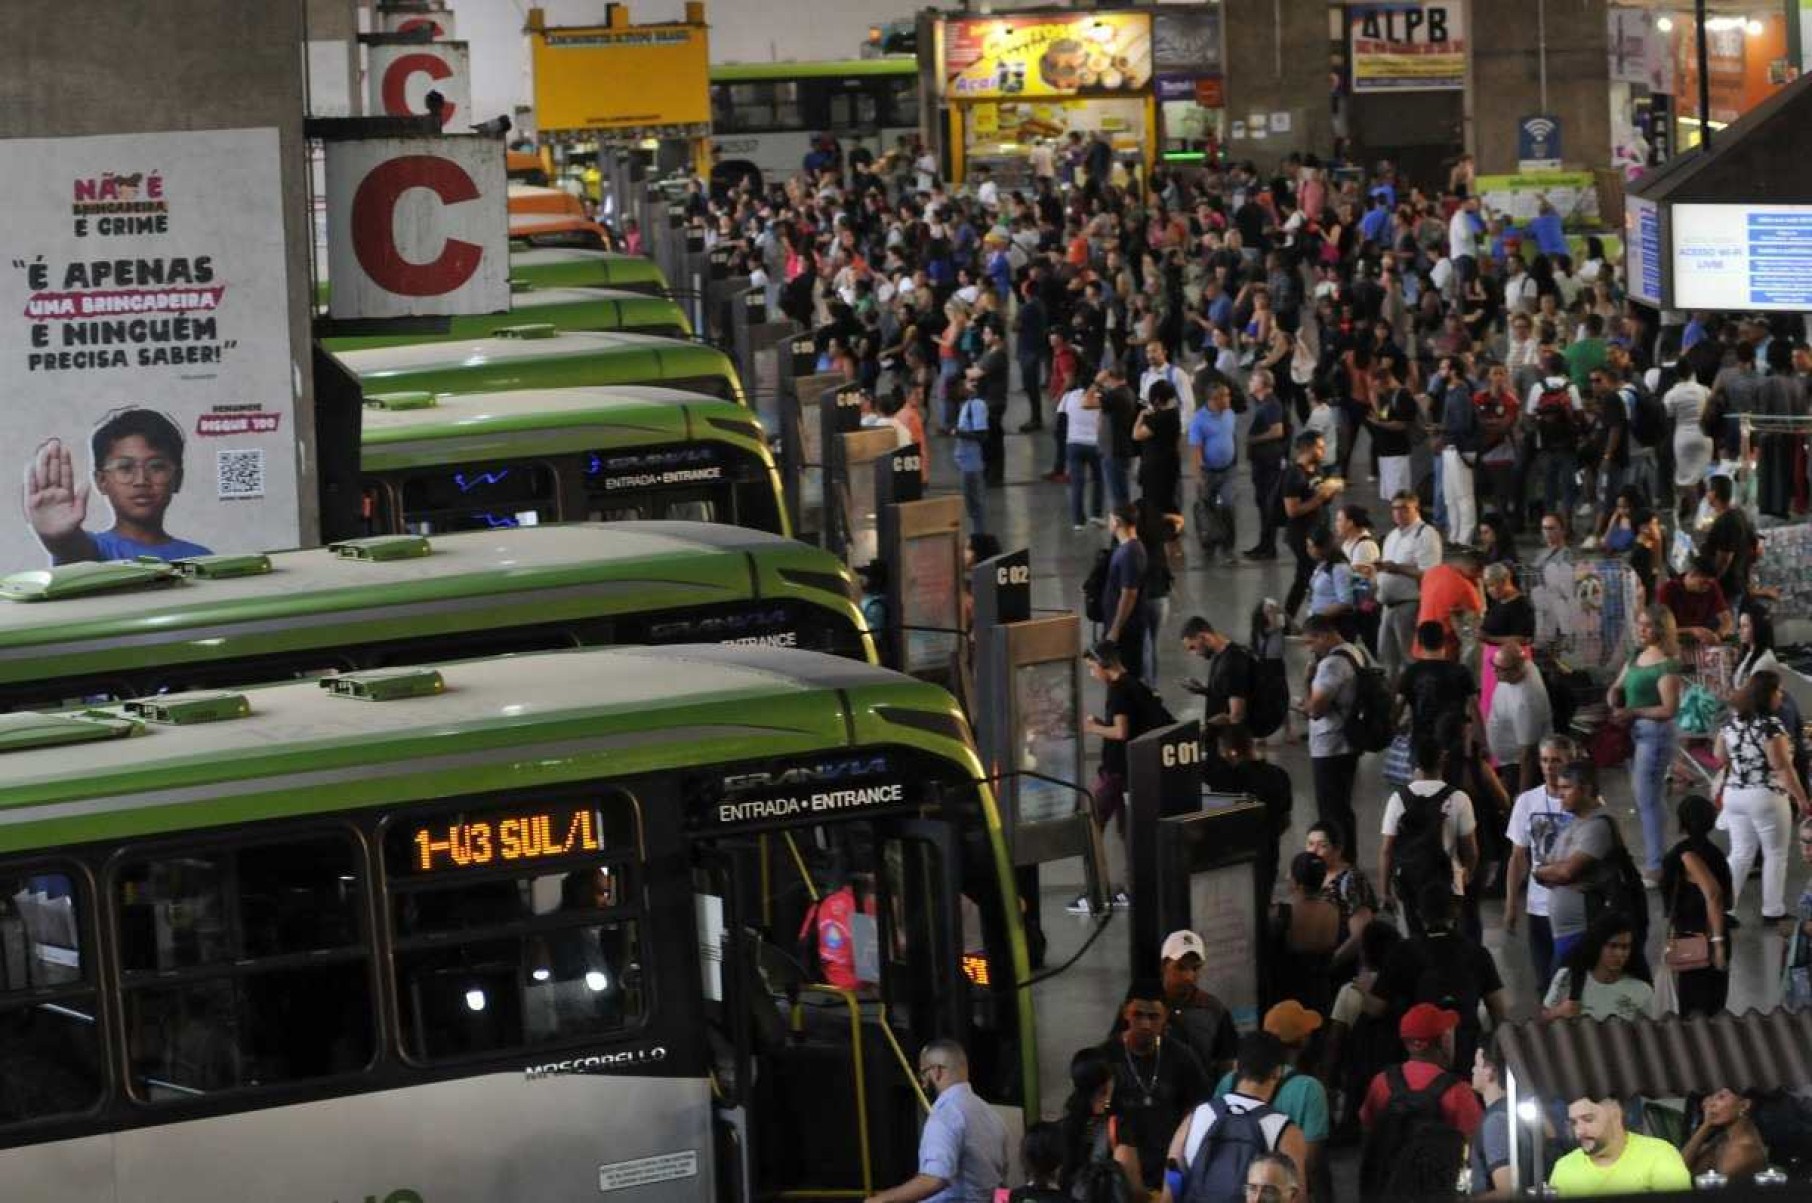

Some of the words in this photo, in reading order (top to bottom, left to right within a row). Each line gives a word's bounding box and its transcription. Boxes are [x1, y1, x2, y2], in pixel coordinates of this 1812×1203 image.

[1361, 8, 1448, 43] ALPB
[382, 53, 457, 126] C
[147, 168, 163, 198] É
[97, 215, 168, 236] CRIME
[351, 155, 484, 297] C
[62, 256, 214, 289] APENAS
[28, 299, 75, 316] UMA
[81, 292, 215, 313] BRINCADEIRA
[31, 323, 49, 347] E
[62, 312, 217, 346] NINGUÉM
[28, 350, 129, 371] PRECISA
[605, 475, 656, 490] ENTRADA
[662, 467, 722, 484] ENTRANCE
[997, 567, 1008, 585] C
[1009, 565, 1029, 584] 02
[1162, 744, 1176, 768] C
[1178, 740, 1200, 765] 01
[719, 798, 800, 822] ENTRADA
[811, 785, 903, 810] ENTRANCE
